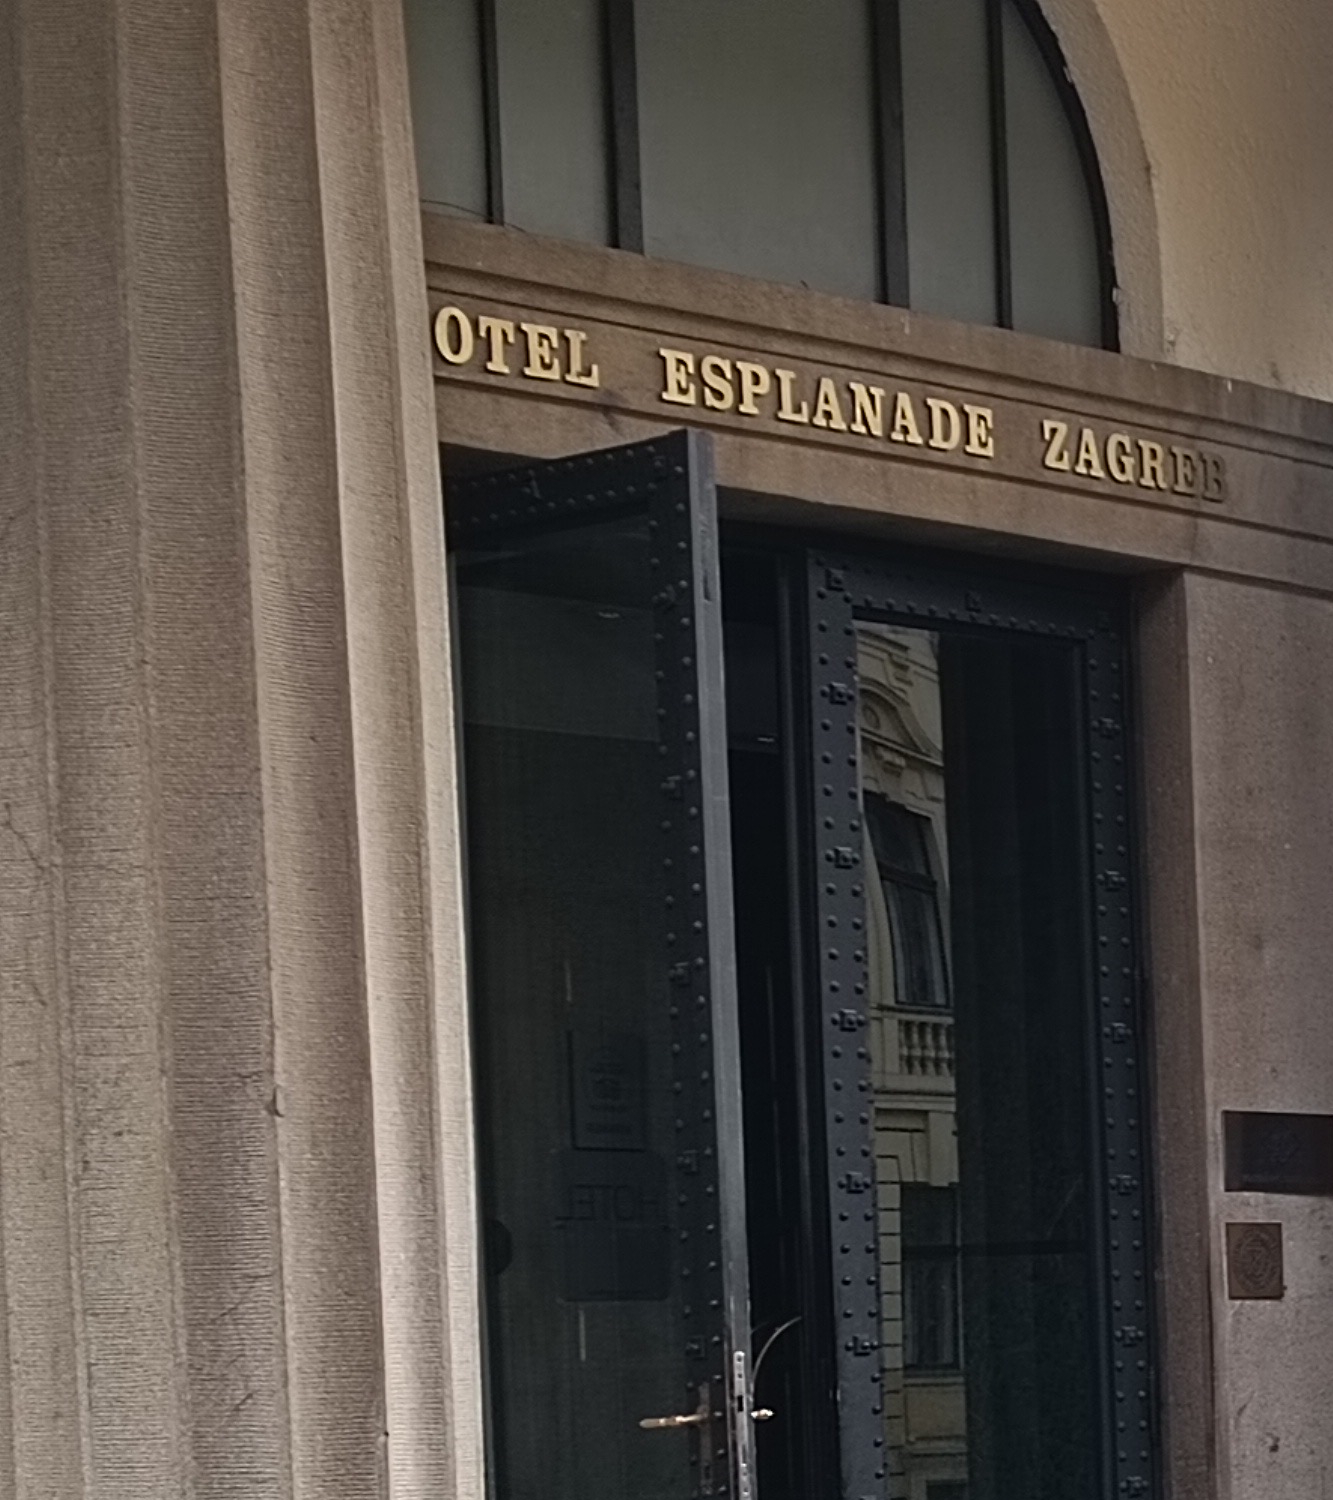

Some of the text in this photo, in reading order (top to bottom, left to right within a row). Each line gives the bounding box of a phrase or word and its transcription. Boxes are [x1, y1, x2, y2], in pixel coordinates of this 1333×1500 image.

[434, 306, 1229, 502] OTEL ESPLANADE ZAGREB
